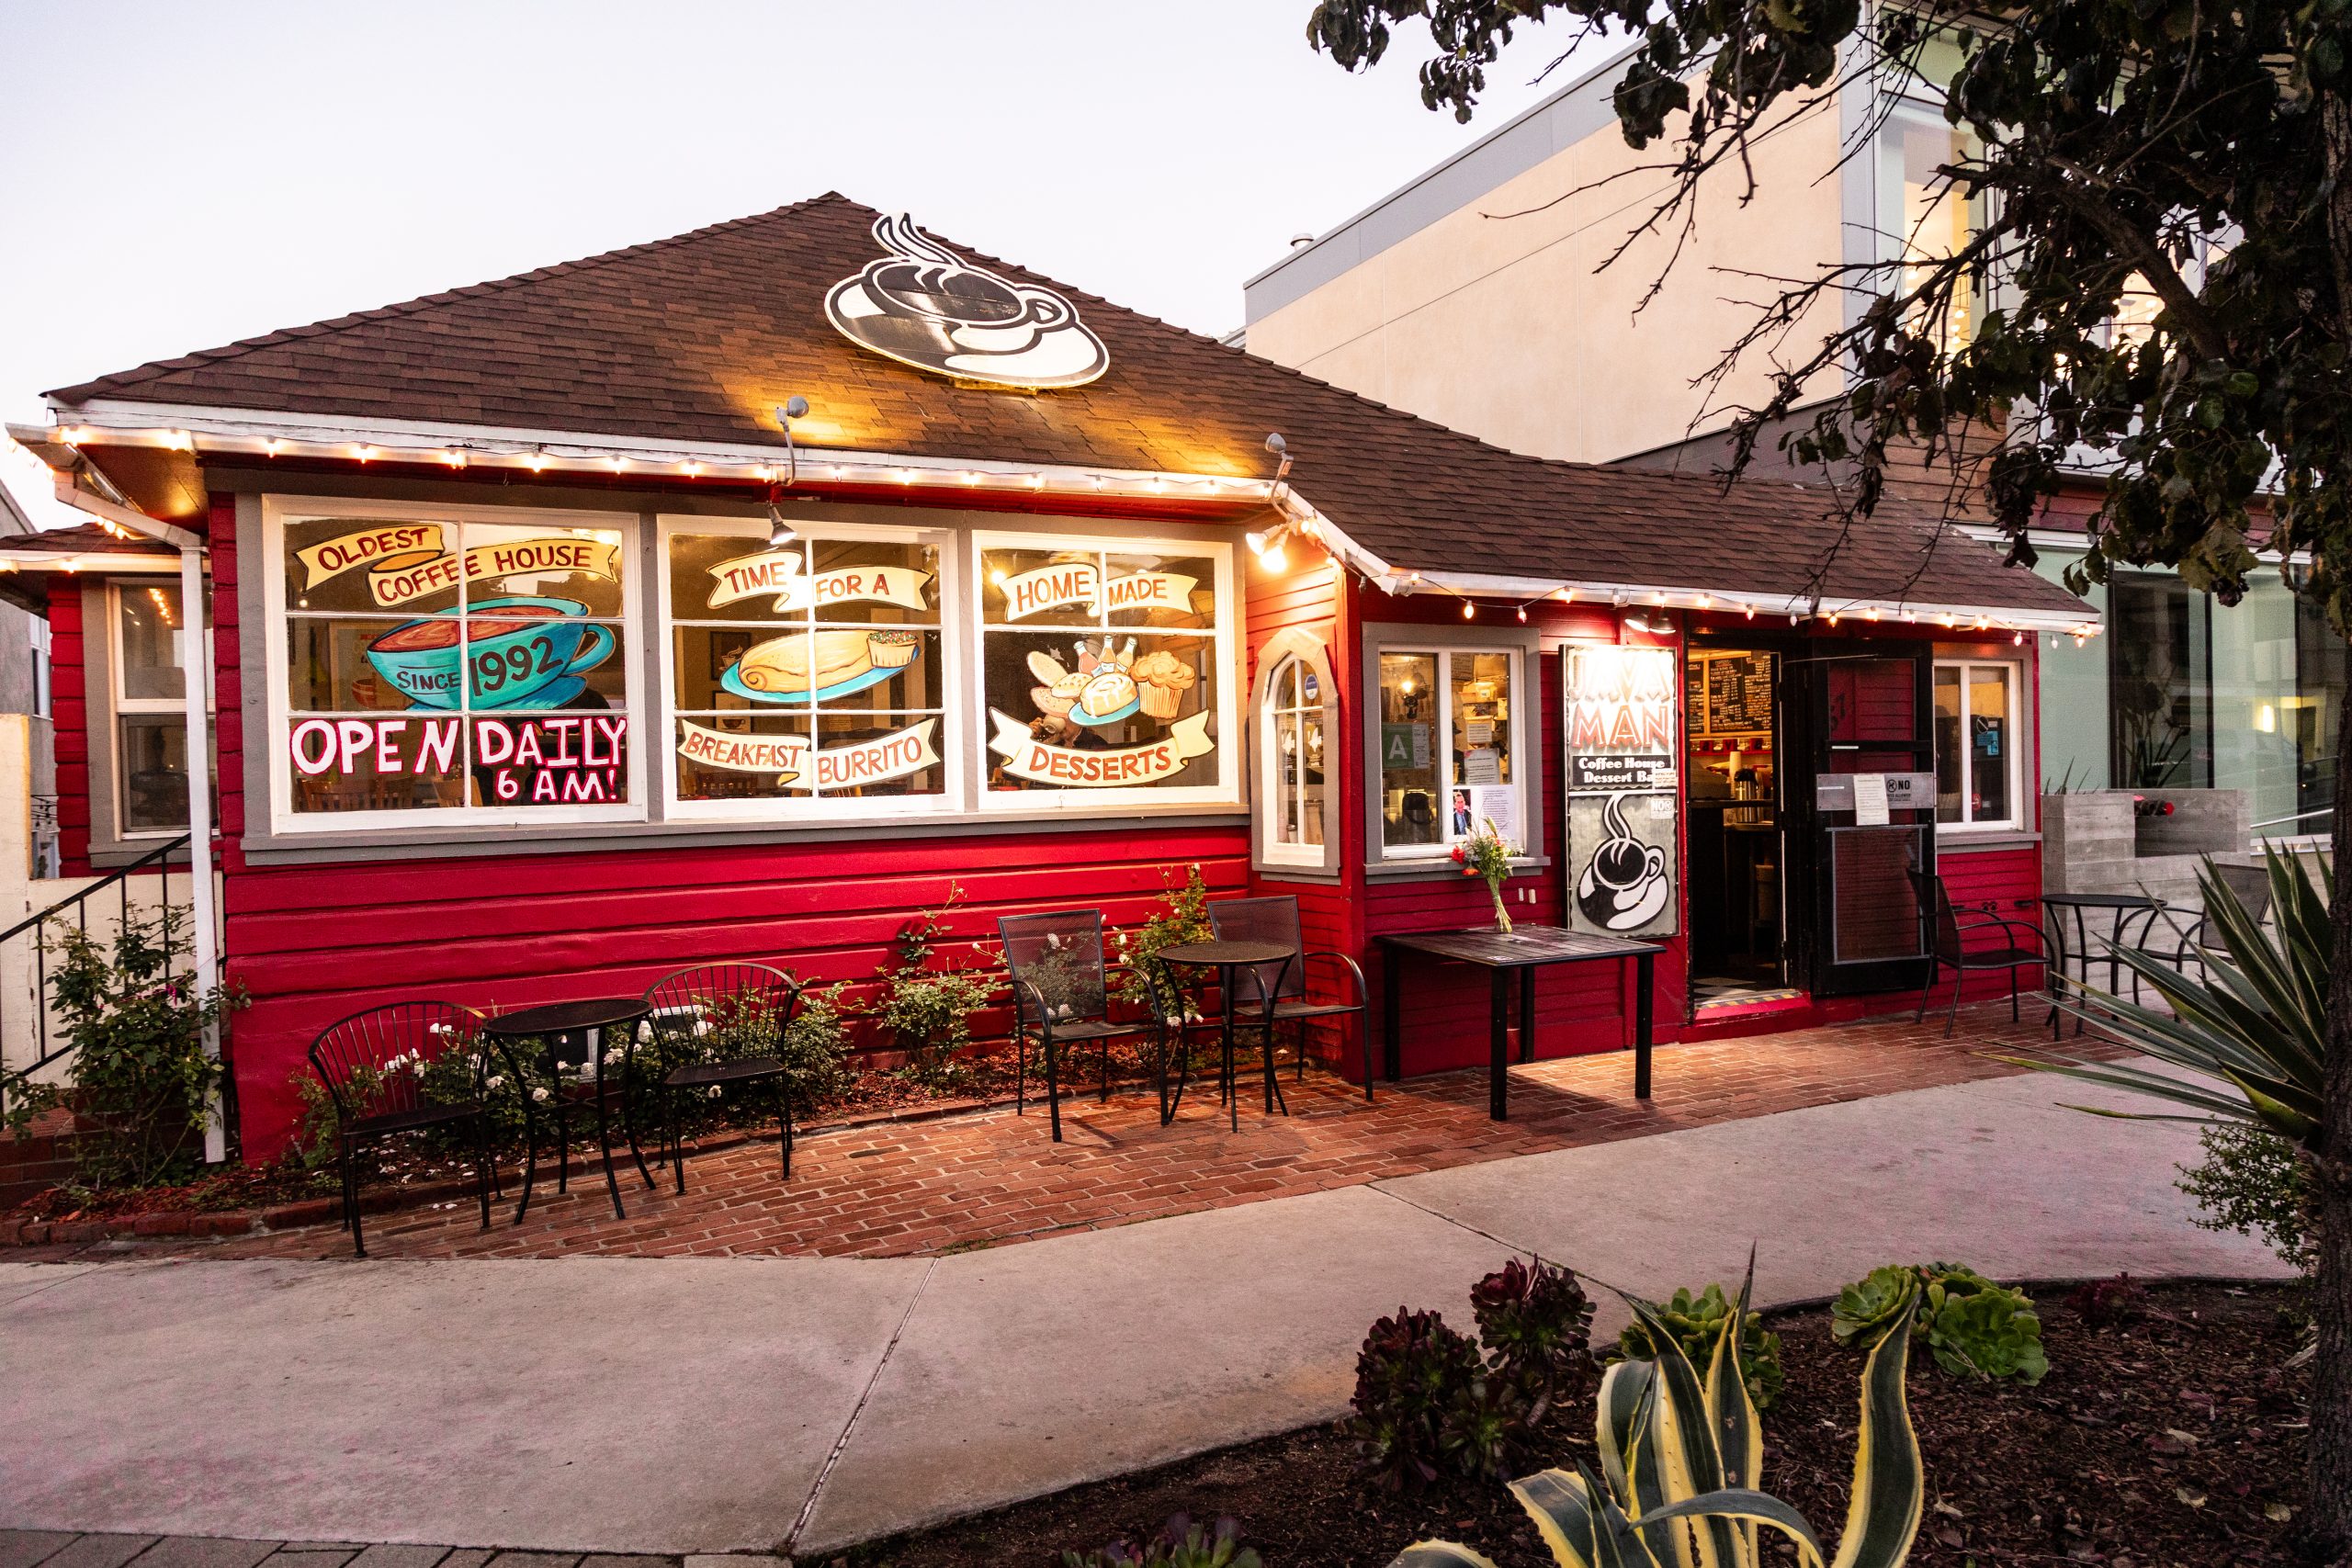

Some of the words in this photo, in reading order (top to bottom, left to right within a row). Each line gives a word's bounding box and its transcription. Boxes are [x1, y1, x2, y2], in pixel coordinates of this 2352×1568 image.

[317, 527, 429, 570] OLDEST
[377, 553, 482, 603] COFFEE
[495, 545, 593, 573] HOUSE
[724, 561, 787, 593] TIME
[816, 574, 863, 602] FOR
[872, 573, 889, 595] A
[1016, 571, 1091, 612] HOME
[1109, 579, 1168, 606] MADE
[397, 671, 459, 691] SINCE
[469, 637, 563, 697] 1992
[290, 718, 458, 774] OPEN
[477, 717, 627, 768] DAILY
[1388, 734, 1408, 760] A
[1569, 704, 1668, 750] MAN
[684, 731, 805, 768] BREAKFAST
[818, 736, 922, 784] BURRITO
[1029, 746, 1171, 781] DESSERTS
[1578, 757, 1623, 770] Coffee
[1584, 771, 1632, 784] Dessert
[1637, 771, 1653, 783] Ba
[496, 771, 519, 801] 6
[533, 769, 616, 802] AM!
[1898, 780, 1910, 790] NO
